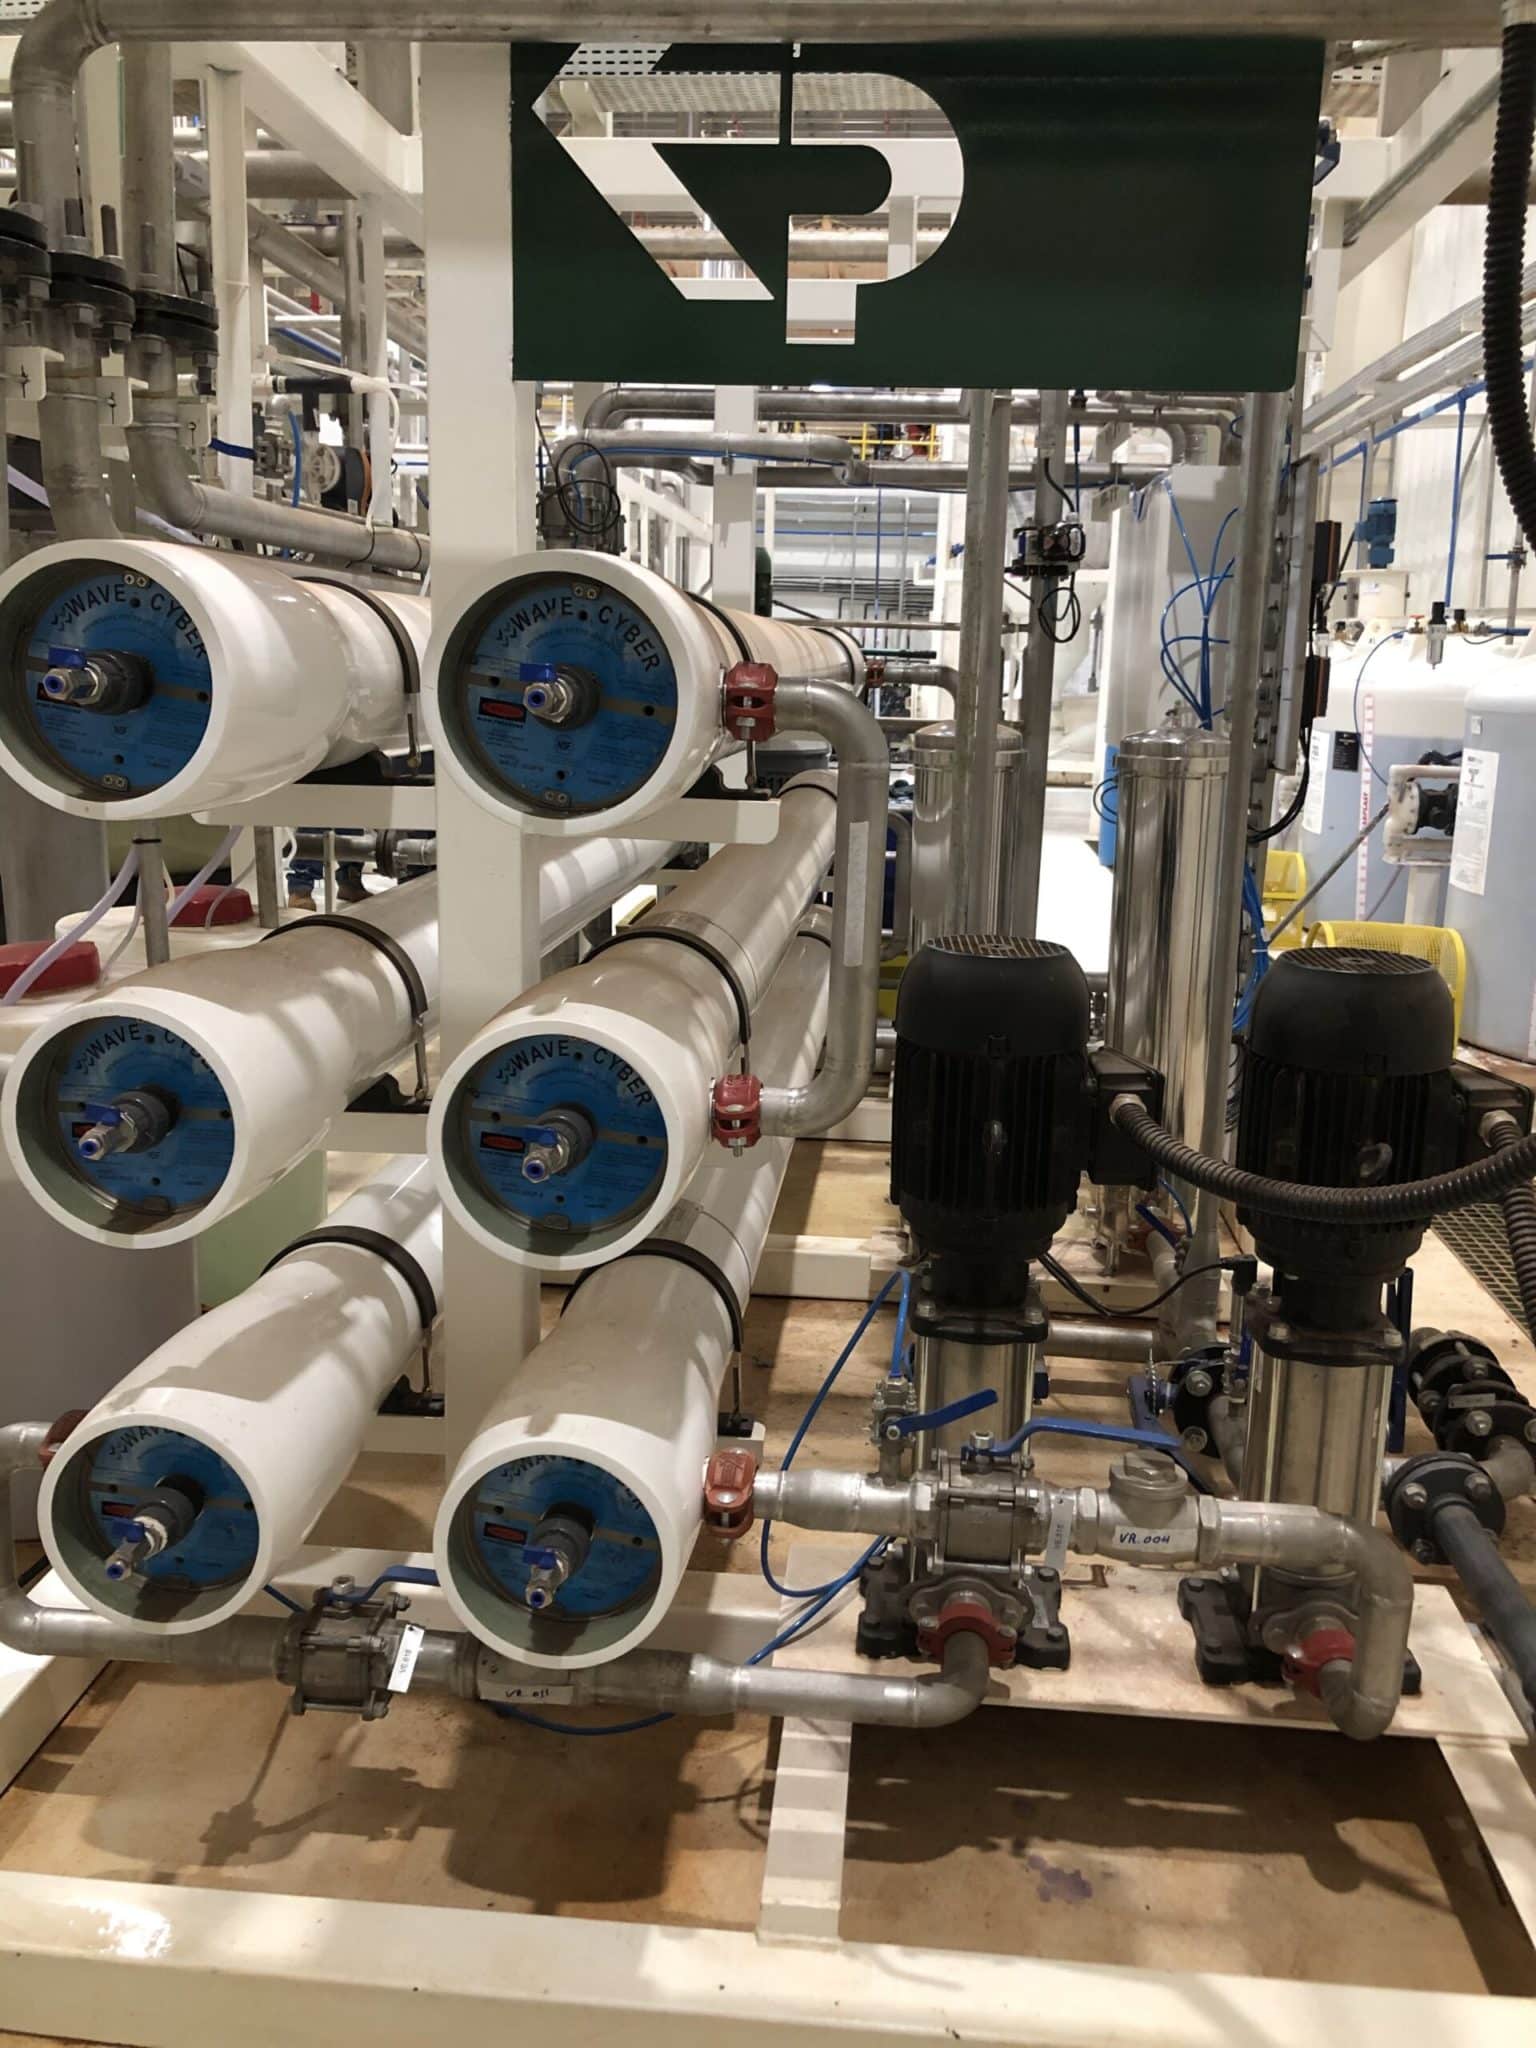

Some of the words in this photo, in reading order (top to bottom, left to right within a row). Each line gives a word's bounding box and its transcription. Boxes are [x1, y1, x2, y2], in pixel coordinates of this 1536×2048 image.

[66, 583, 127, 618] WAVE
[510, 596, 574, 633] WAVE
[598, 604, 661, 673] CYBER
[87, 1022, 143, 1060] WAVE
[510, 1039, 571, 1072] WAVE
[593, 1048, 653, 1108] CYBER
